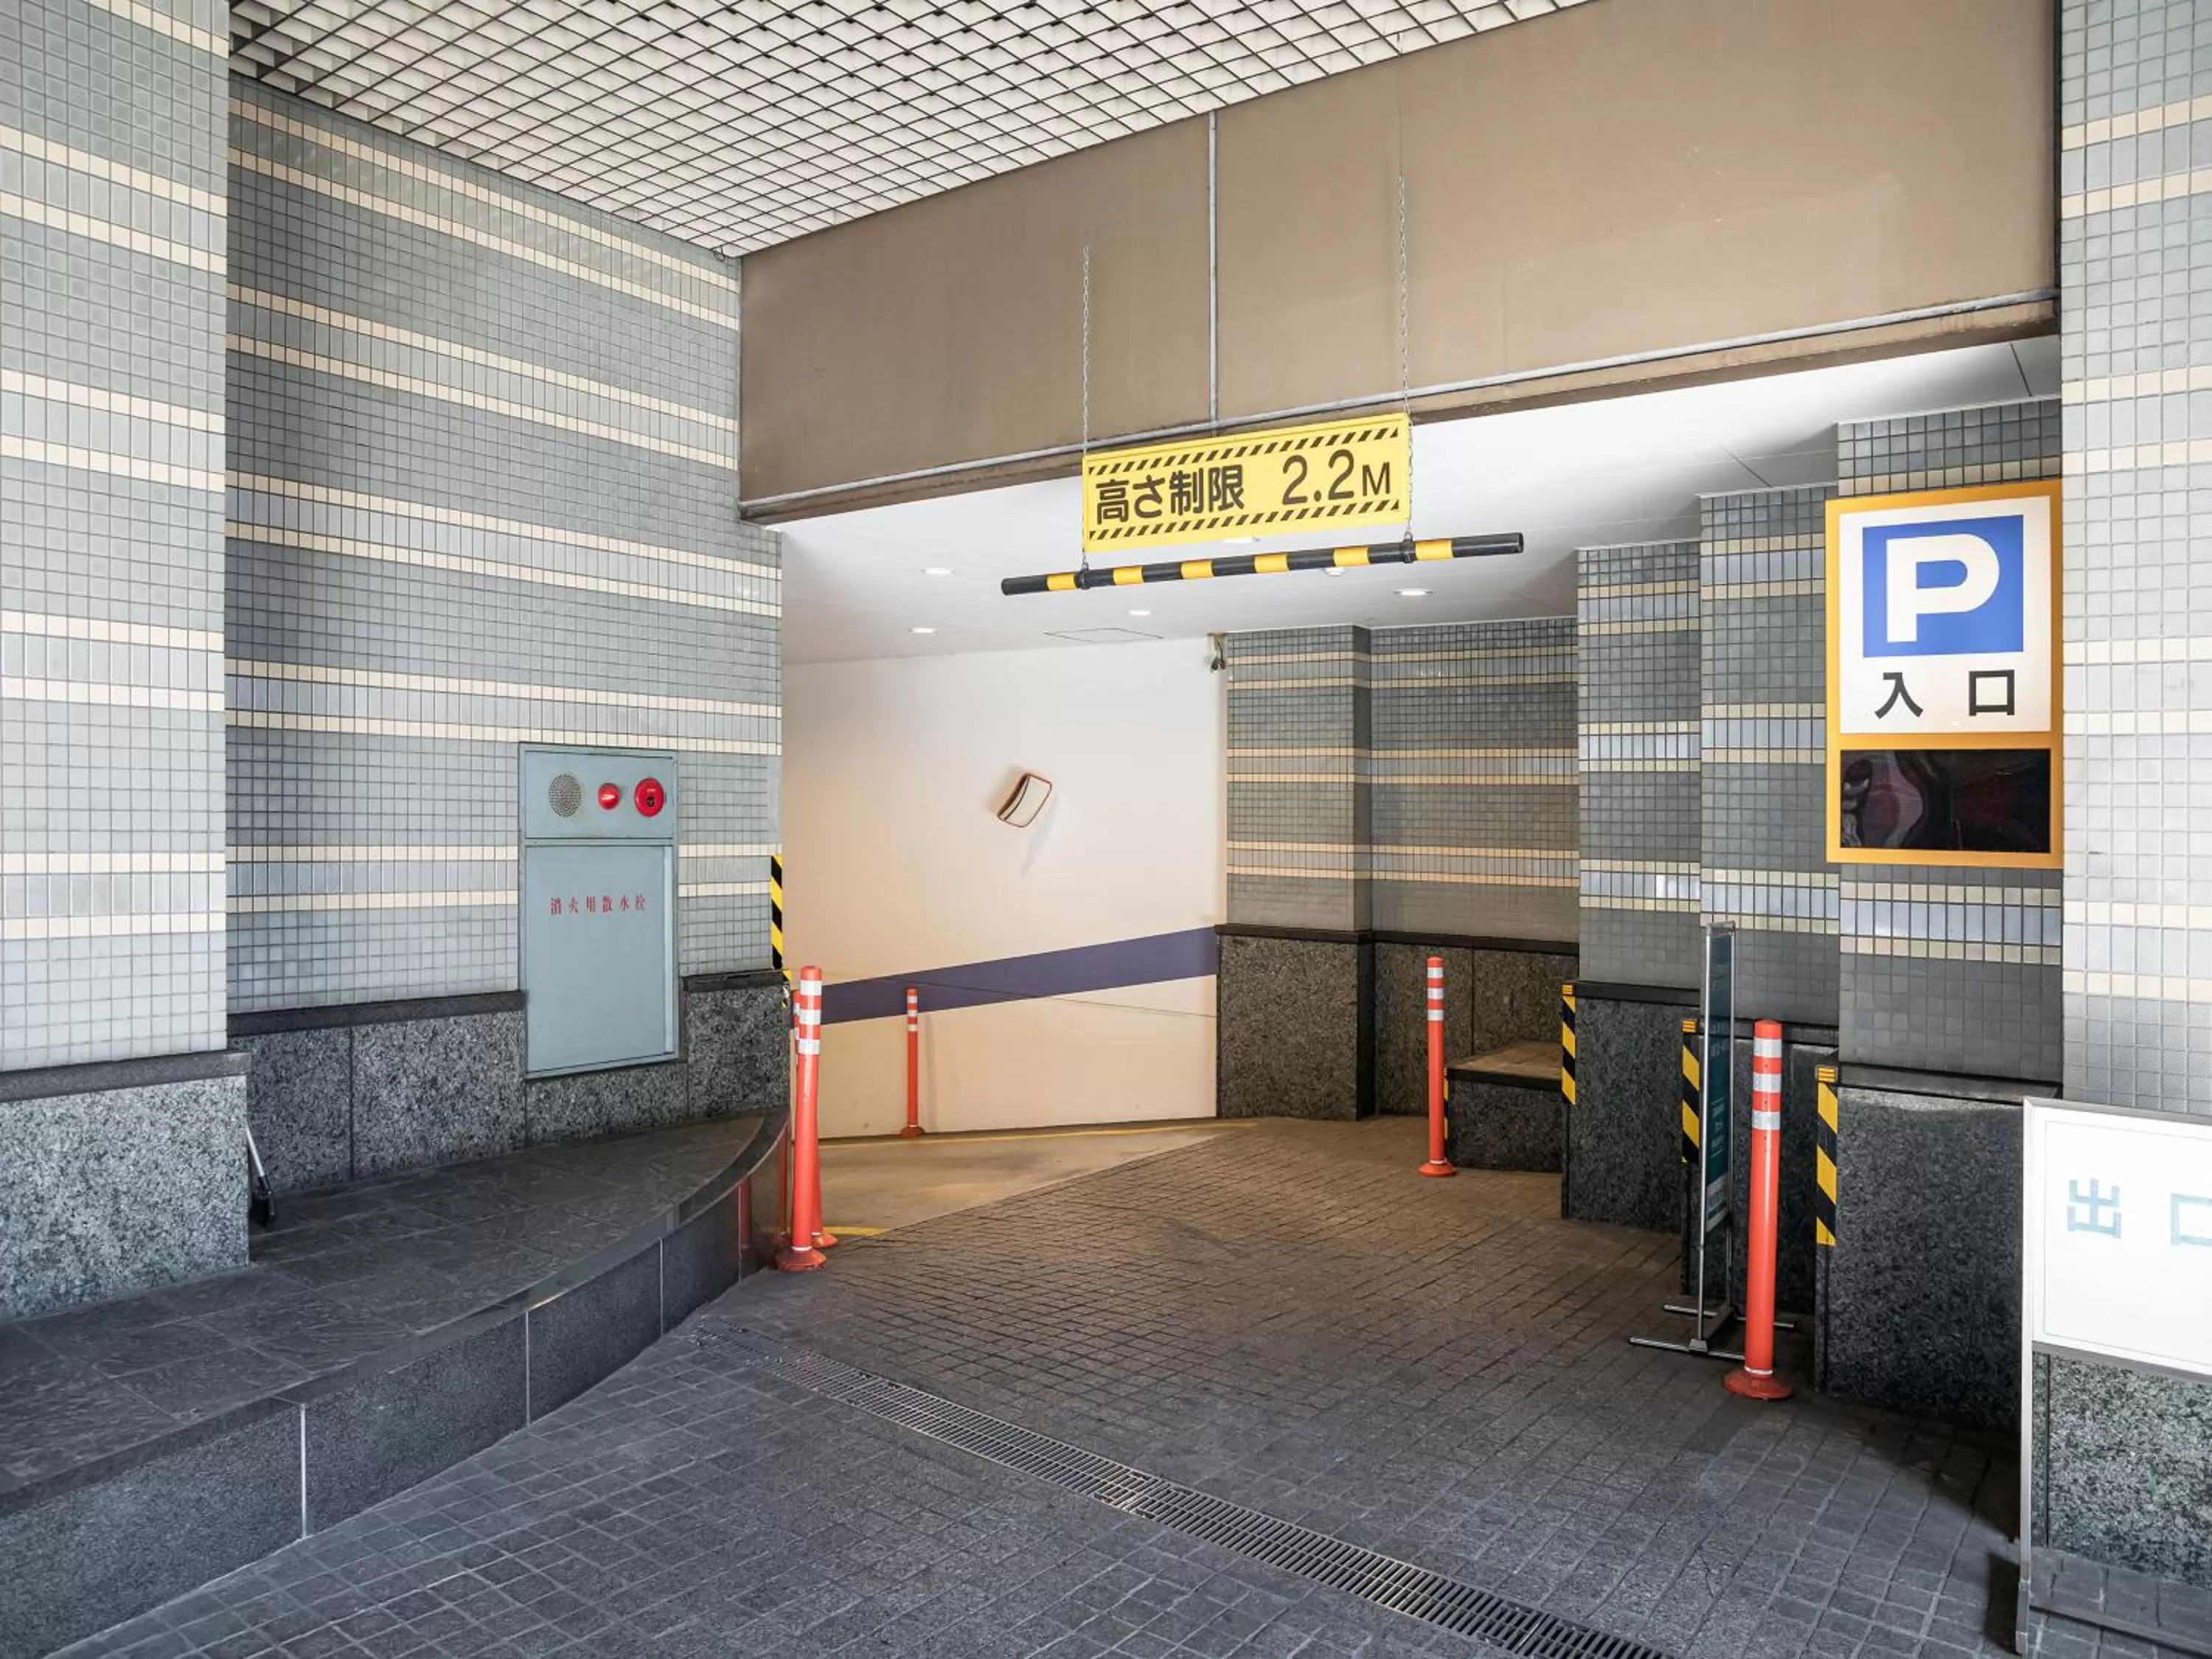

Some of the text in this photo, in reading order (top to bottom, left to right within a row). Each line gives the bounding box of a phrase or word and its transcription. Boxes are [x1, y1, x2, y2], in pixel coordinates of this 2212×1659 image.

[1096, 449, 1391, 525] 高さ制限 2.2M
[1886, 533, 2000, 643] P
[1874, 669, 2016, 720] 入口
